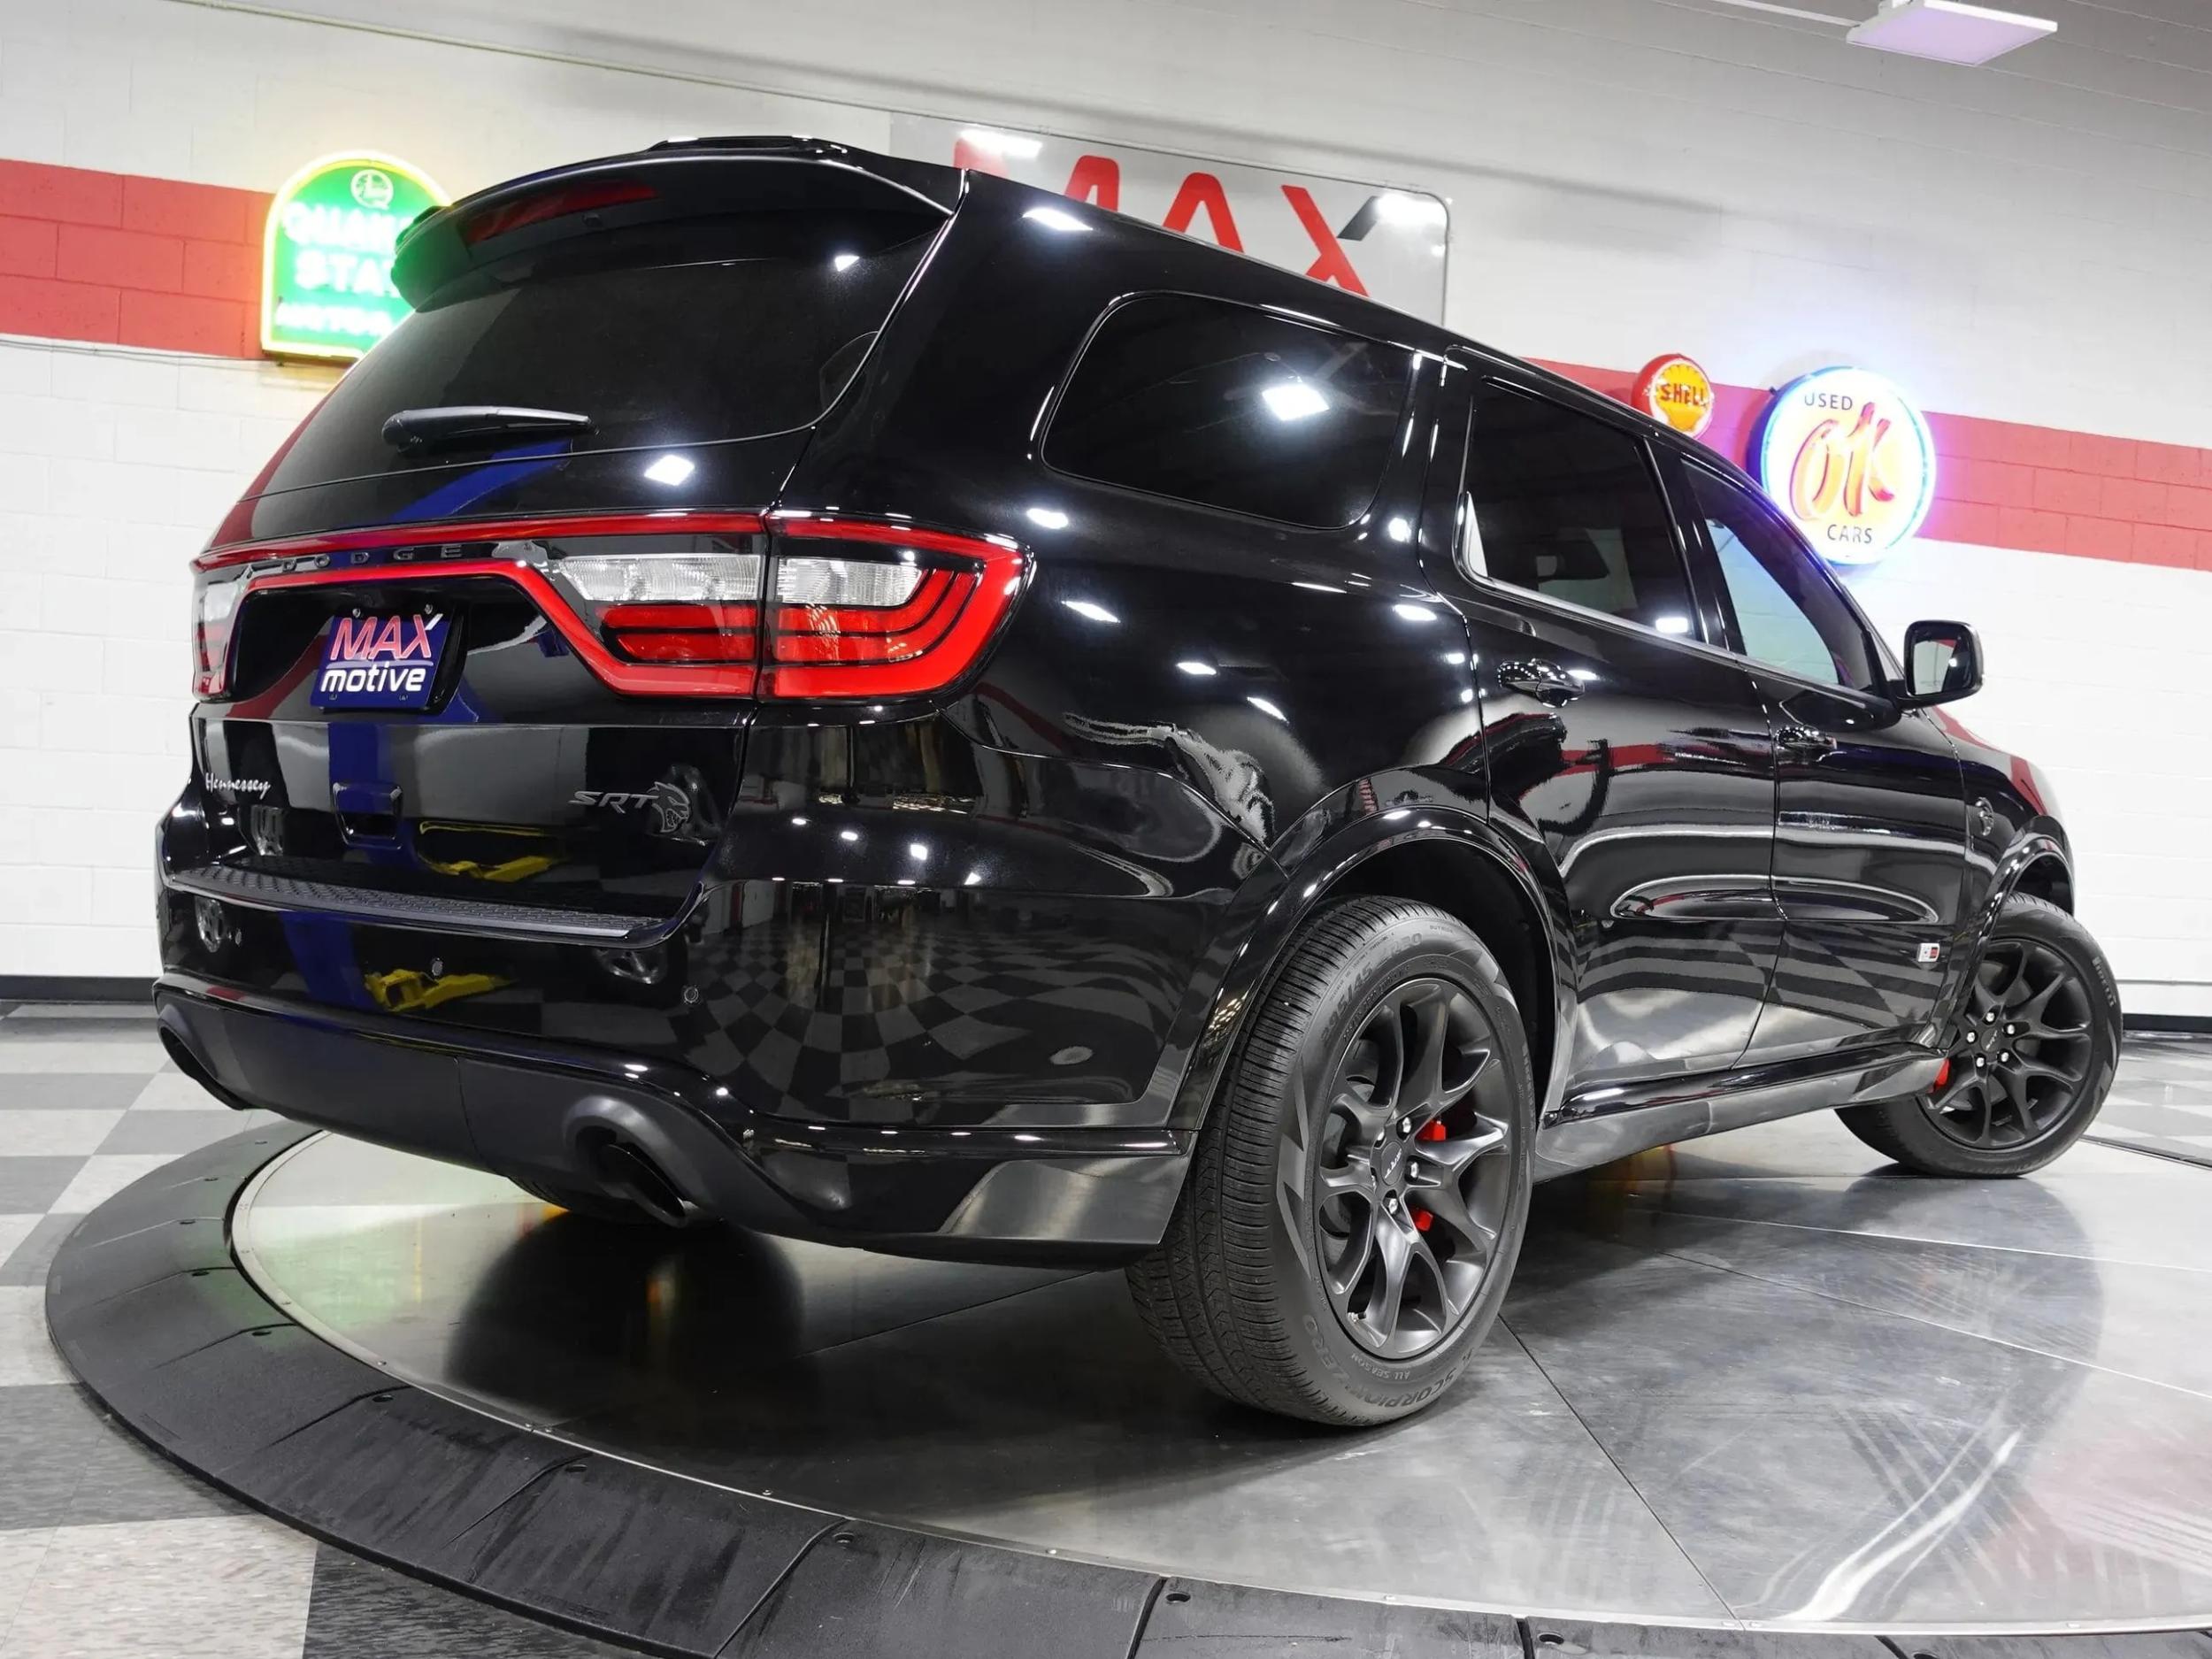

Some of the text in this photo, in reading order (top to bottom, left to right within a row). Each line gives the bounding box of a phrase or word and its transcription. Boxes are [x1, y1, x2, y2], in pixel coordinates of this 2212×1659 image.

[954, 139, 1382, 297] AX
[1660, 382, 1708, 407] SHELL
[1803, 393, 1854, 411] USED
[1826, 524, 1873, 545] CARS
[281, 543, 463, 572] DODGE
[329, 613, 443, 661] MAX
[319, 661, 426, 693] motive
[204, 772, 272, 800] Hennessey
[567, 790, 660, 814] SRT
